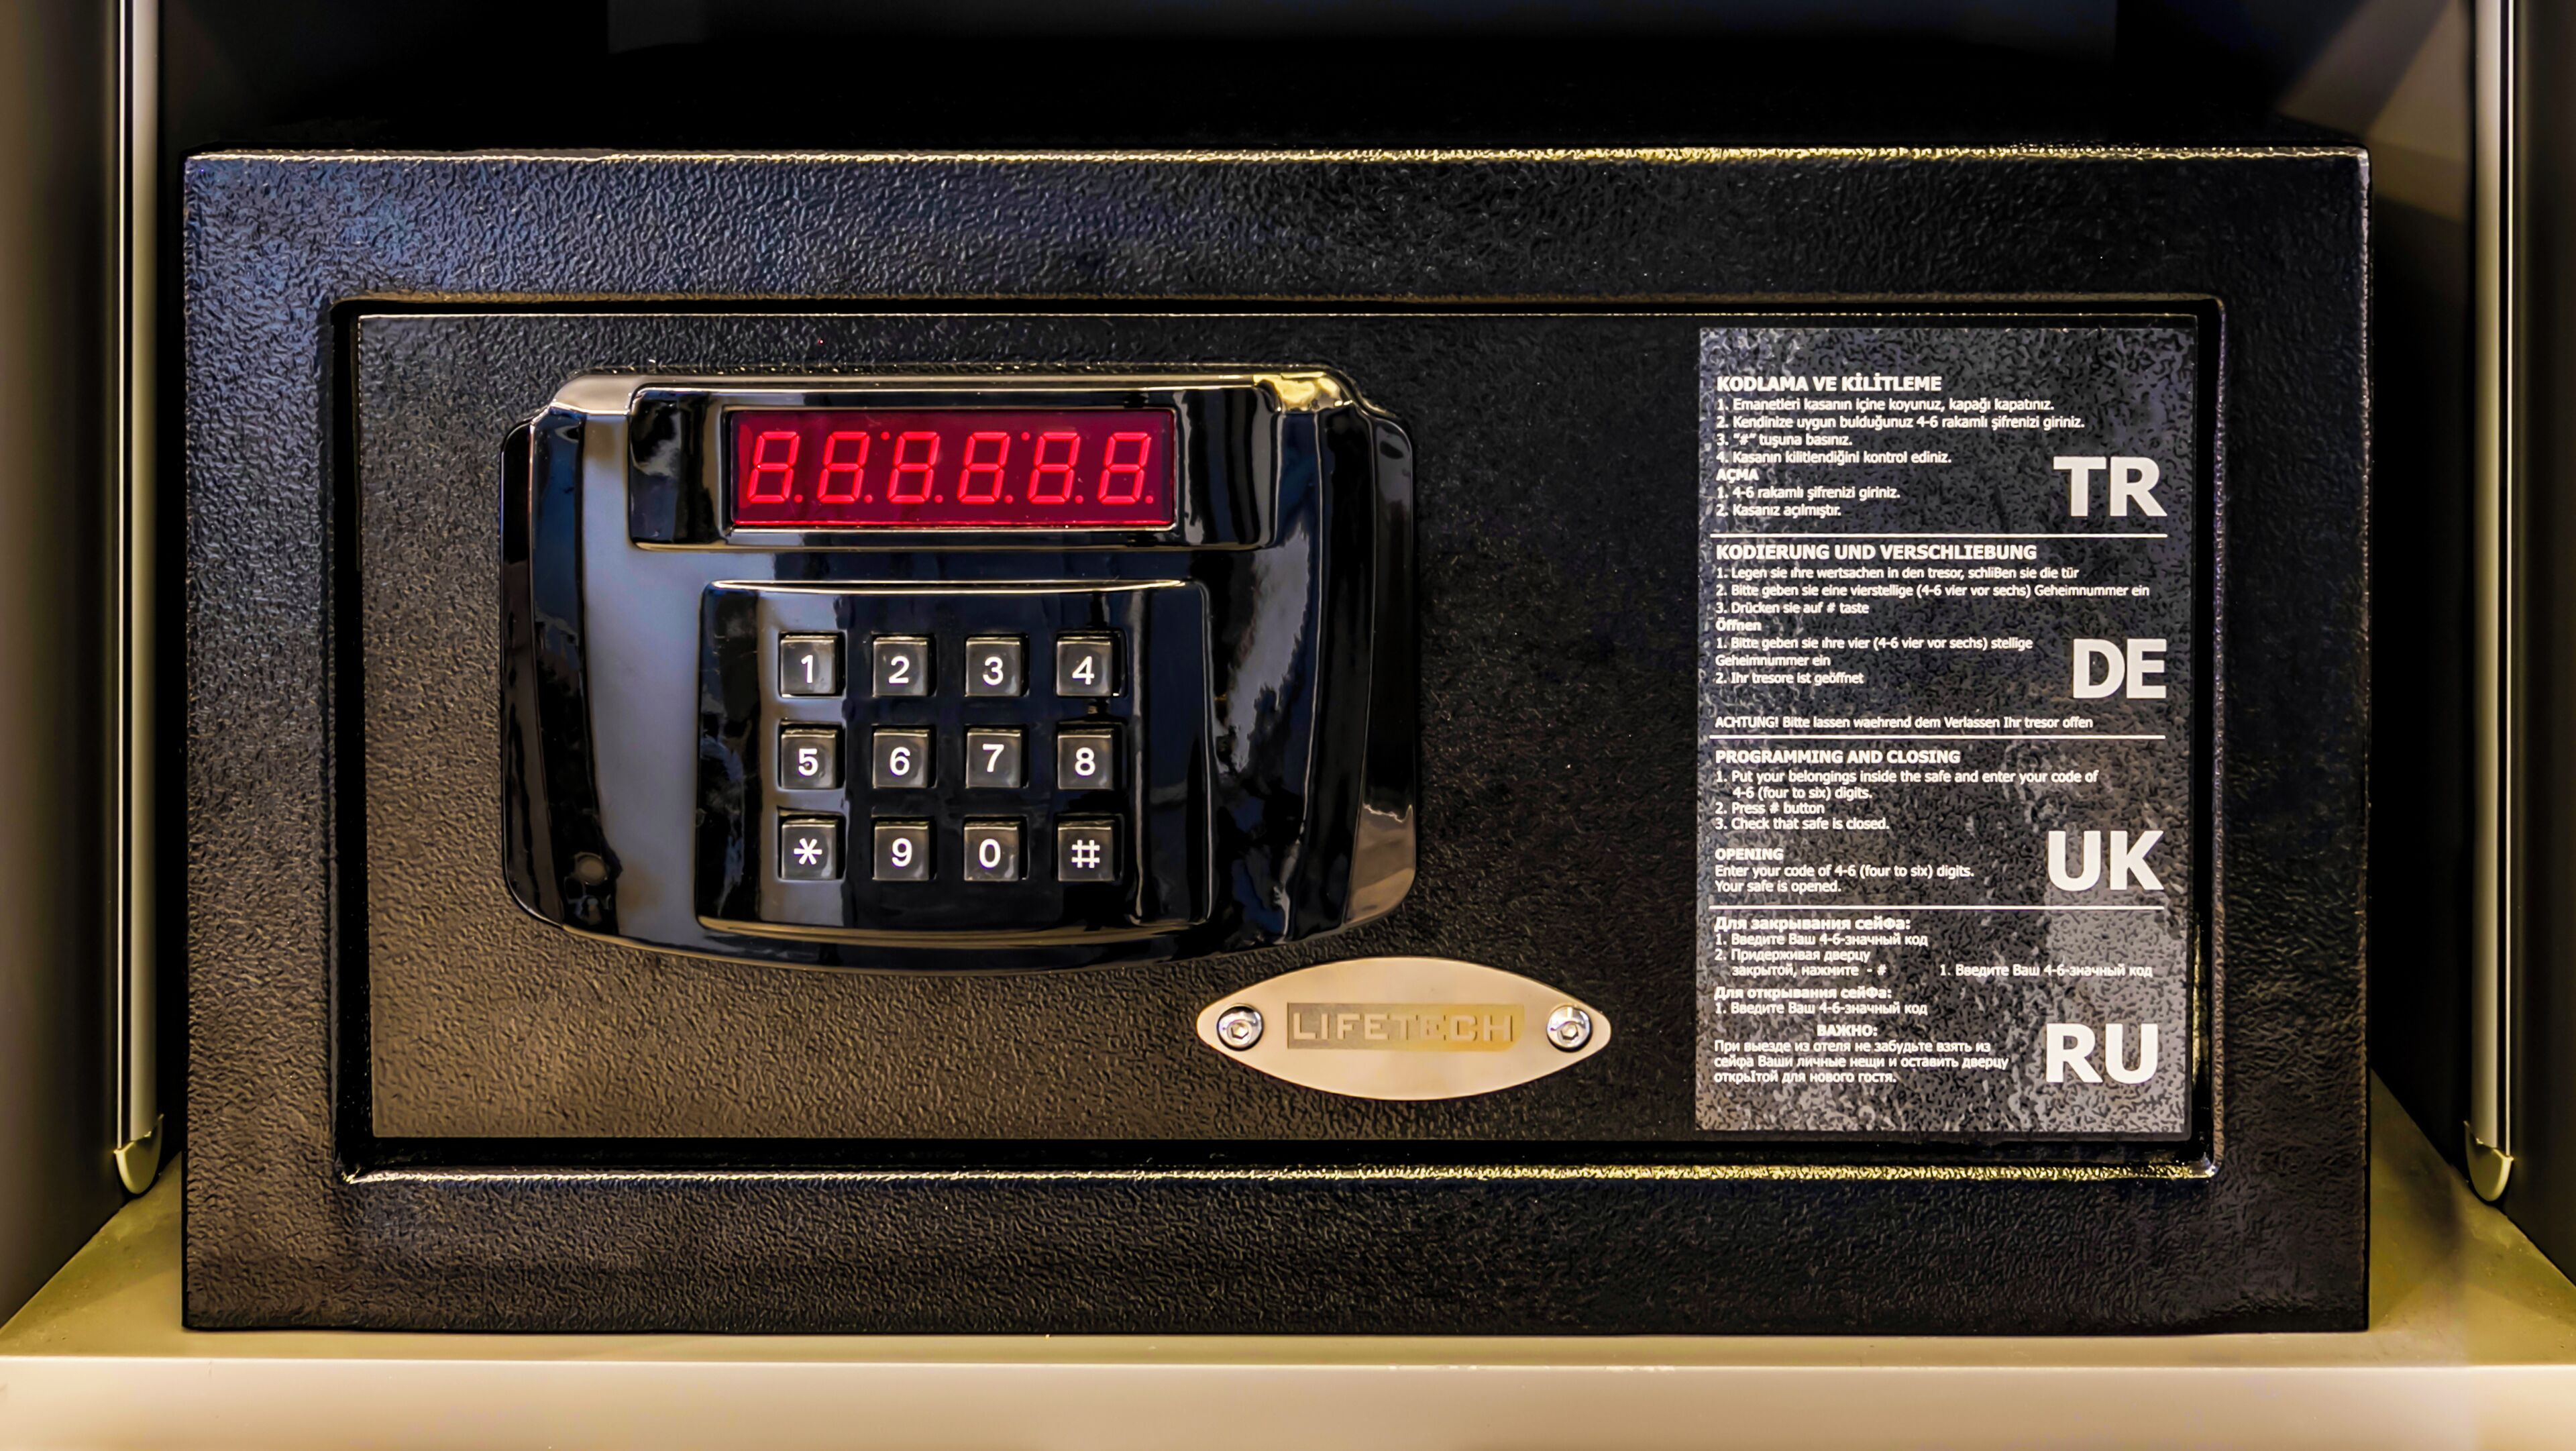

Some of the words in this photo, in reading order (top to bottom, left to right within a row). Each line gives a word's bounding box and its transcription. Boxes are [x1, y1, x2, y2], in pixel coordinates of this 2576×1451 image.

[1717, 376, 1809, 391] KODLAMA
[1813, 376, 1837, 391] VE
[1842, 372, 1941, 391] KİLİTLEME
[1717, 398, 1729, 410] 1.
[1733, 398, 1800, 410] Emanetleri
[1805, 398, 1851, 410] kasanın
[1856, 398, 1885, 413] içine
[1889, 398, 1945, 413] koyunuz,
[1949, 398, 1990, 413] kapağı
[1994, 398, 2054, 413] kapatınız.
[1716, 416, 1729, 428] 2.
[1733, 416, 1794, 428] Kendinize
[1797, 419, 1835, 431] uygun
[1840, 416, 1913, 431] bulduğunuz
[1917, 416, 1938, 428] 4-6
[1943, 416, 1987, 428] rakamlı
[1992, 416, 2039, 431] şifrenizi
[2043, 416, 2085, 431] giriniz.
[1717, 451, 1728, 463] 4.
[1733, 451, 1781, 463] Kasanın
[1785, 451, 1859, 466] kilitlendiğini
[1864, 451, 1907, 463] kontrol
[1911, 451, 1951, 463] ediniz.
[1717, 469, 1759, 484] AÇMA
[1717, 486, 1728, 498] 1.
[1732, 486, 1754, 498] 4-6
[1758, 486, 1803, 498] rakamlı
[1807, 486, 1855, 501] şifrenizi
[1859, 486, 1900, 501] giriniz.
[2053, 456, 2167, 517] TR
[1717, 504, 1728, 515] 2.
[1733, 504, 1780, 515] Kasanız
[1784, 504, 1841, 519] açılmıştır.
[1716, 545, 1829, 559] KODIERUNG
[1835, 545, 1876, 559] UND
[1716, 585, 1727, 596] 2.
[1731, 585, 1758, 596] Bitte
[1762, 585, 1798, 598] geben
[1802, 585, 1819, 596] sie
[1822, 585, 1847, 596] eine
[1850, 585, 1913, 598] vierstellige
[1917, 585, 1941, 598] (4-6
[1945, 585, 1967, 596] vier
[1970, 588, 1989, 596] vor
[1993, 585, 2031, 598] sechs)
[2034, 585, 2128, 596] Geheimnummer
[2132, 585, 2149, 596] ein
[1716, 619, 1762, 631] Öffnen
[801, 655, 814, 684] 1
[888, 655, 910, 684] 2
[982, 656, 1004, 686] 3
[1072, 655, 1095, 685] 4
[2073, 639, 2167, 699] DE
[1716, 672, 1727, 684] 2.
[1731, 672, 1749, 684] Ihr
[1752, 672, 1794, 684] tresore
[1797, 672, 1811, 684] ist
[1814, 672, 1864, 686] geöffnet
[1715, 716, 1778, 727] ACHTUNG!
[1783, 716, 1810, 727] Bitte
[1813, 716, 1850, 727] lassen
[1853, 716, 1911, 727] waehrend
[1915, 716, 1941, 727] dem
[1944, 716, 2000, 727] Verlassen
[2004, 716, 2021, 727] Ihr
[2025, 716, 2059, 727] tresor
[2063, 716, 2093, 727] offen
[798, 748, 818, 776] 5
[889, 747, 910, 775] 6
[982, 743, 1004, 772] 7
[1075, 747, 1095, 776] 8
[1716, 750, 1843, 763] PROGRAMMING
[1847, 750, 1883, 763] AND
[1886, 750, 1960, 763] CLOSING
[1716, 770, 1727, 782] 1.
[1732, 770, 1753, 782] Put
[1757, 773, 1785, 785] your
[1789, 770, 1857, 785] belongings
[1860, 770, 1896, 782] inside
[1900, 770, 1921, 782] the
[1925, 770, 1951, 782] safe
[1955, 770, 1978, 782] and
[1982, 770, 2017, 782] enter
[2019, 773, 2047, 785] your
[2051, 770, 2081, 782] code
[2085, 770, 2098, 782] of
[1733, 787, 1754, 798] 4-6
[1758, 787, 1788, 801] (four
[1792, 787, 1805, 798] to
[1809, 787, 1831, 801] six)
[1835, 787, 1872, 801] digits.
[1715, 802, 1727, 814] 2.
[1732, 802, 1766, 814] Press
[1784, 802, 1825, 814] button
[1715, 818, 1727, 829] 3.
[1731, 818, 1770, 829] Check
[1774, 818, 1799, 829] that
[1803, 818, 1829, 829] safe
[1833, 818, 1843, 829] is
[1846, 818, 1889, 829] closed.
[892, 838, 912, 867] 9
[1715, 848, 1783, 860] OPENING
[2048, 830, 2164, 891] UK
[1715, 865, 1748, 877] Enter
[1752, 868, 1780, 879] your
[1784, 865, 1814, 877] code
[1818, 865, 1832, 877] of
[1835, 865, 1856, 877] 4-6
[1860, 865, 1891, 879] (four
[1894, 865, 1907, 877] to
[1911, 865, 1933, 879] six)
[1937, 865, 1974, 879] digits.
[1715, 880, 1744, 892] Your
[1747, 880, 1774, 892] safe
[1778, 880, 1787, 892] is
[1791, 880, 1841, 894] opened.
[1715, 917, 1747, 931] Для
[1751, 919, 1850, 931] закрывания
[1716, 934, 1727, 945] 1.
[1731, 934, 1784, 947] Введите
[1789, 934, 1815, 945] Ваш
[1819, 933, 1900, 945] 4-6-значный
[1904, 936, 1928, 947] код
[1715, 949, 1727, 960] 2.
[1731, 949, 1820, 963] Придерживая
[1824, 952, 1870, 963] дверцу
[1714, 987, 1743, 1000] Для
[1748, 989, 1837, 1000] открывания
[1293, 1012, 1513, 1041] LIFETECH
[1817, 1025, 1878, 1036] ВАЖНО:
[1715, 1040, 1740, 1054] При
[1744, 1042, 1790, 1054] выезде
[1794, 1042, 1810, 1052] из
[1813, 1042, 1851, 1052] отеля
[1855, 1042, 1871, 1052] не
[1874, 1040, 1933, 1054] забудьте
[1937, 1042, 1972, 1052] взять
[1976, 1042, 1990, 1052] из
[2047, 1023, 2158, 1084] RU
[1758, 1055, 1792, 1067] Ваши
[1796, 1058, 1846, 1067] личные
[1888, 1058, 1897, 1067] и
[1901, 1058, 1959, 1067] оставить
[1962, 1058, 2009, 1069] дверцу
